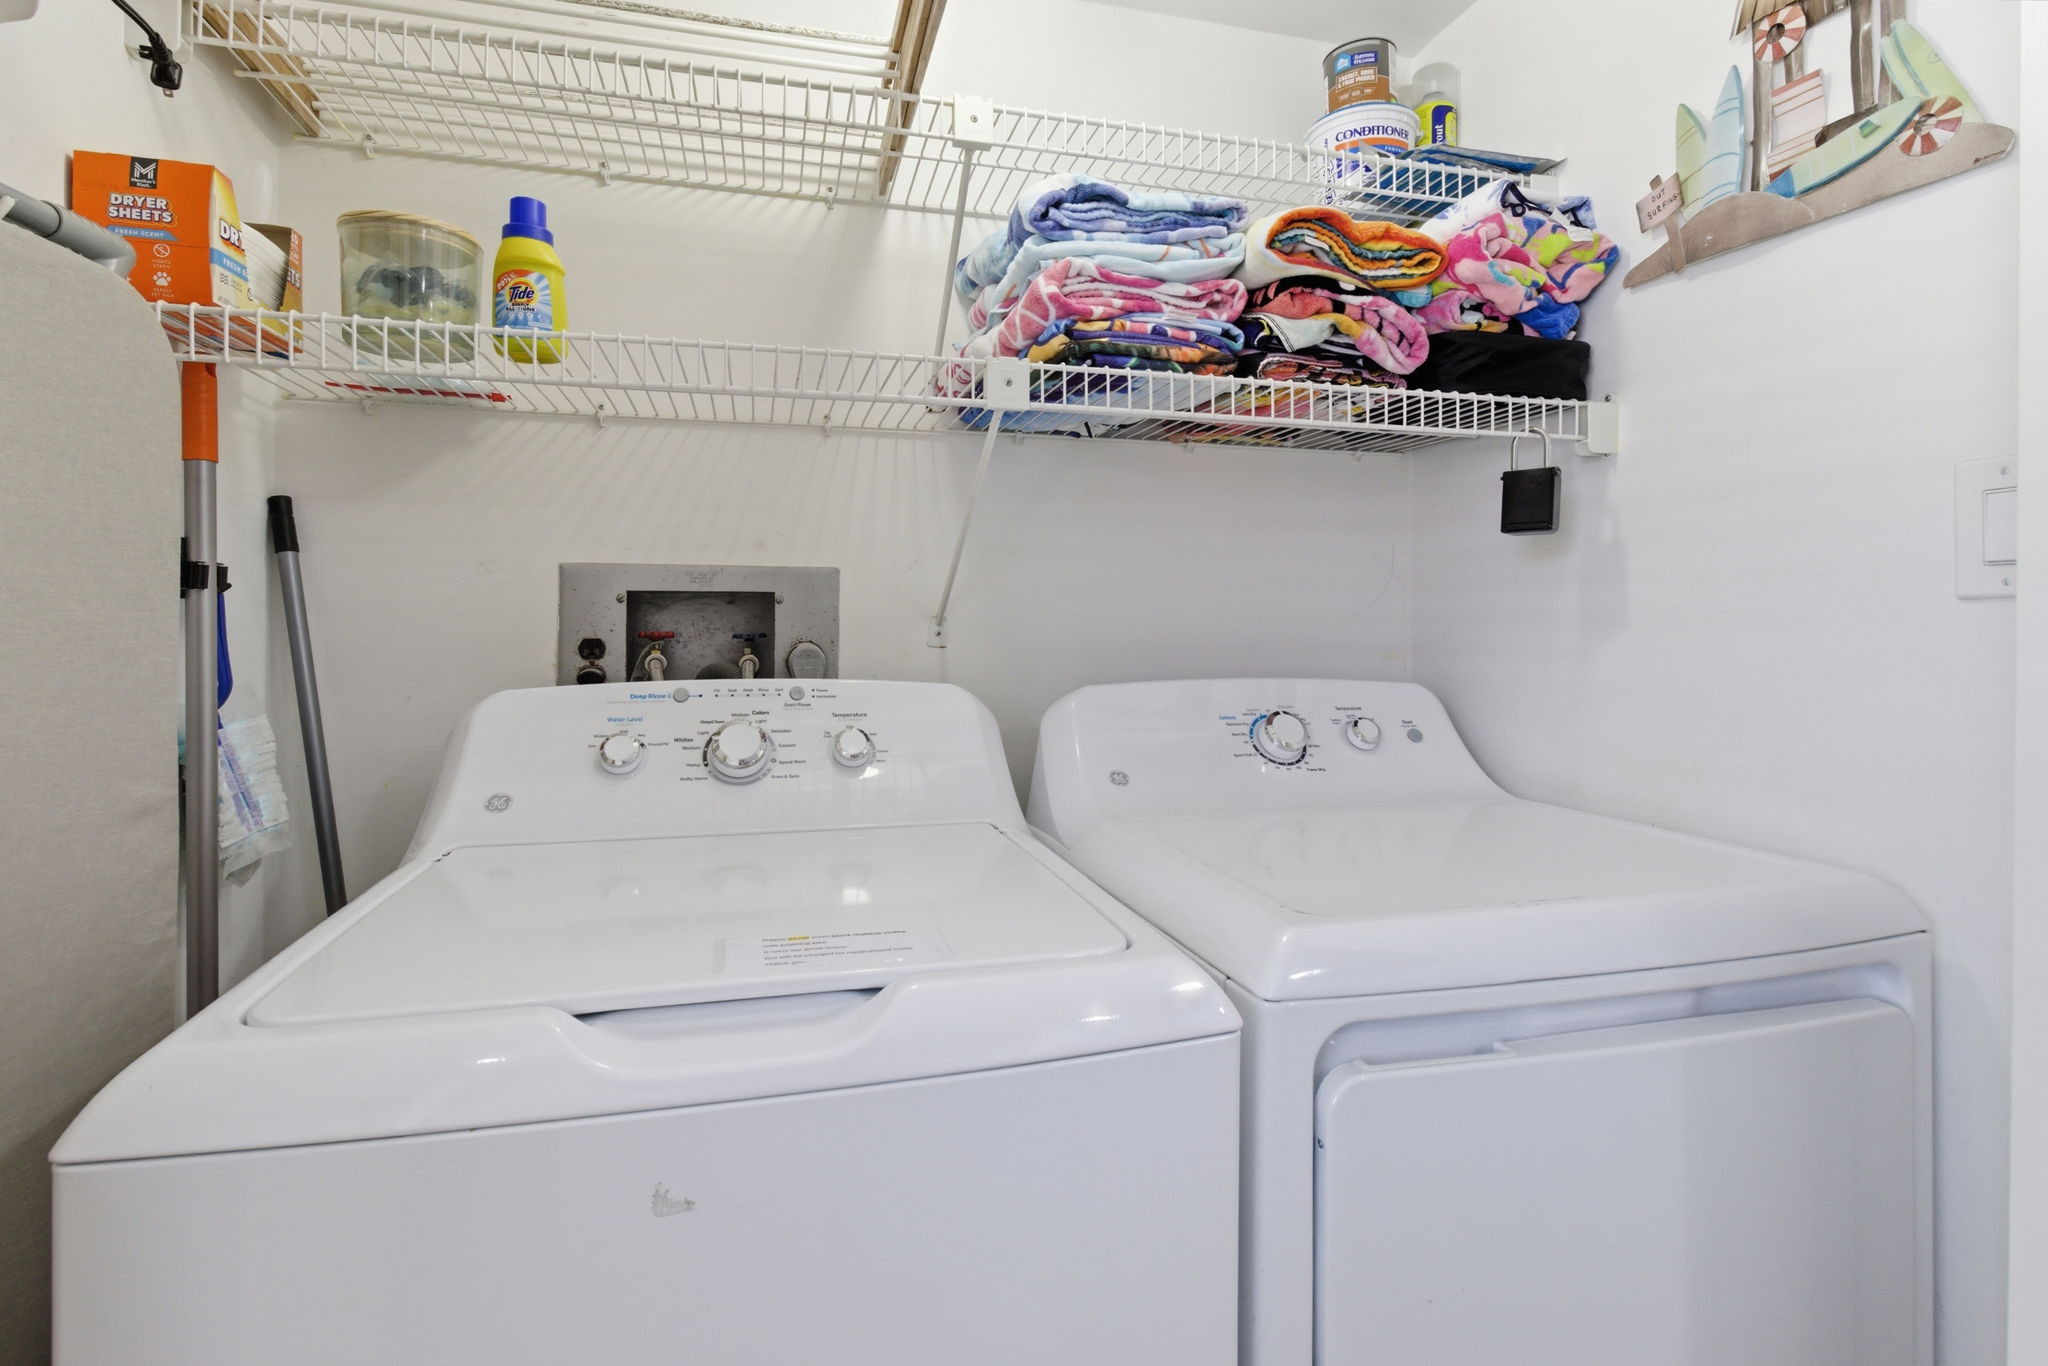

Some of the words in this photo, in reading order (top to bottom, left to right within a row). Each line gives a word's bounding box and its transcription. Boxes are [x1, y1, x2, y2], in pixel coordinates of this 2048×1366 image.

[1335, 125, 1408, 142] CONDITIONER
[110, 193, 168, 210] DRYER
[1651, 188, 1665, 202] OUT
[108, 206, 173, 223] SHEETS
[1647, 193, 1678, 220] SURFING
[114, 227, 139, 236] FRESH
[509, 286, 535, 302] Tide
[630, 693, 648, 701] Deep
[648, 692, 667, 700] Rinse
